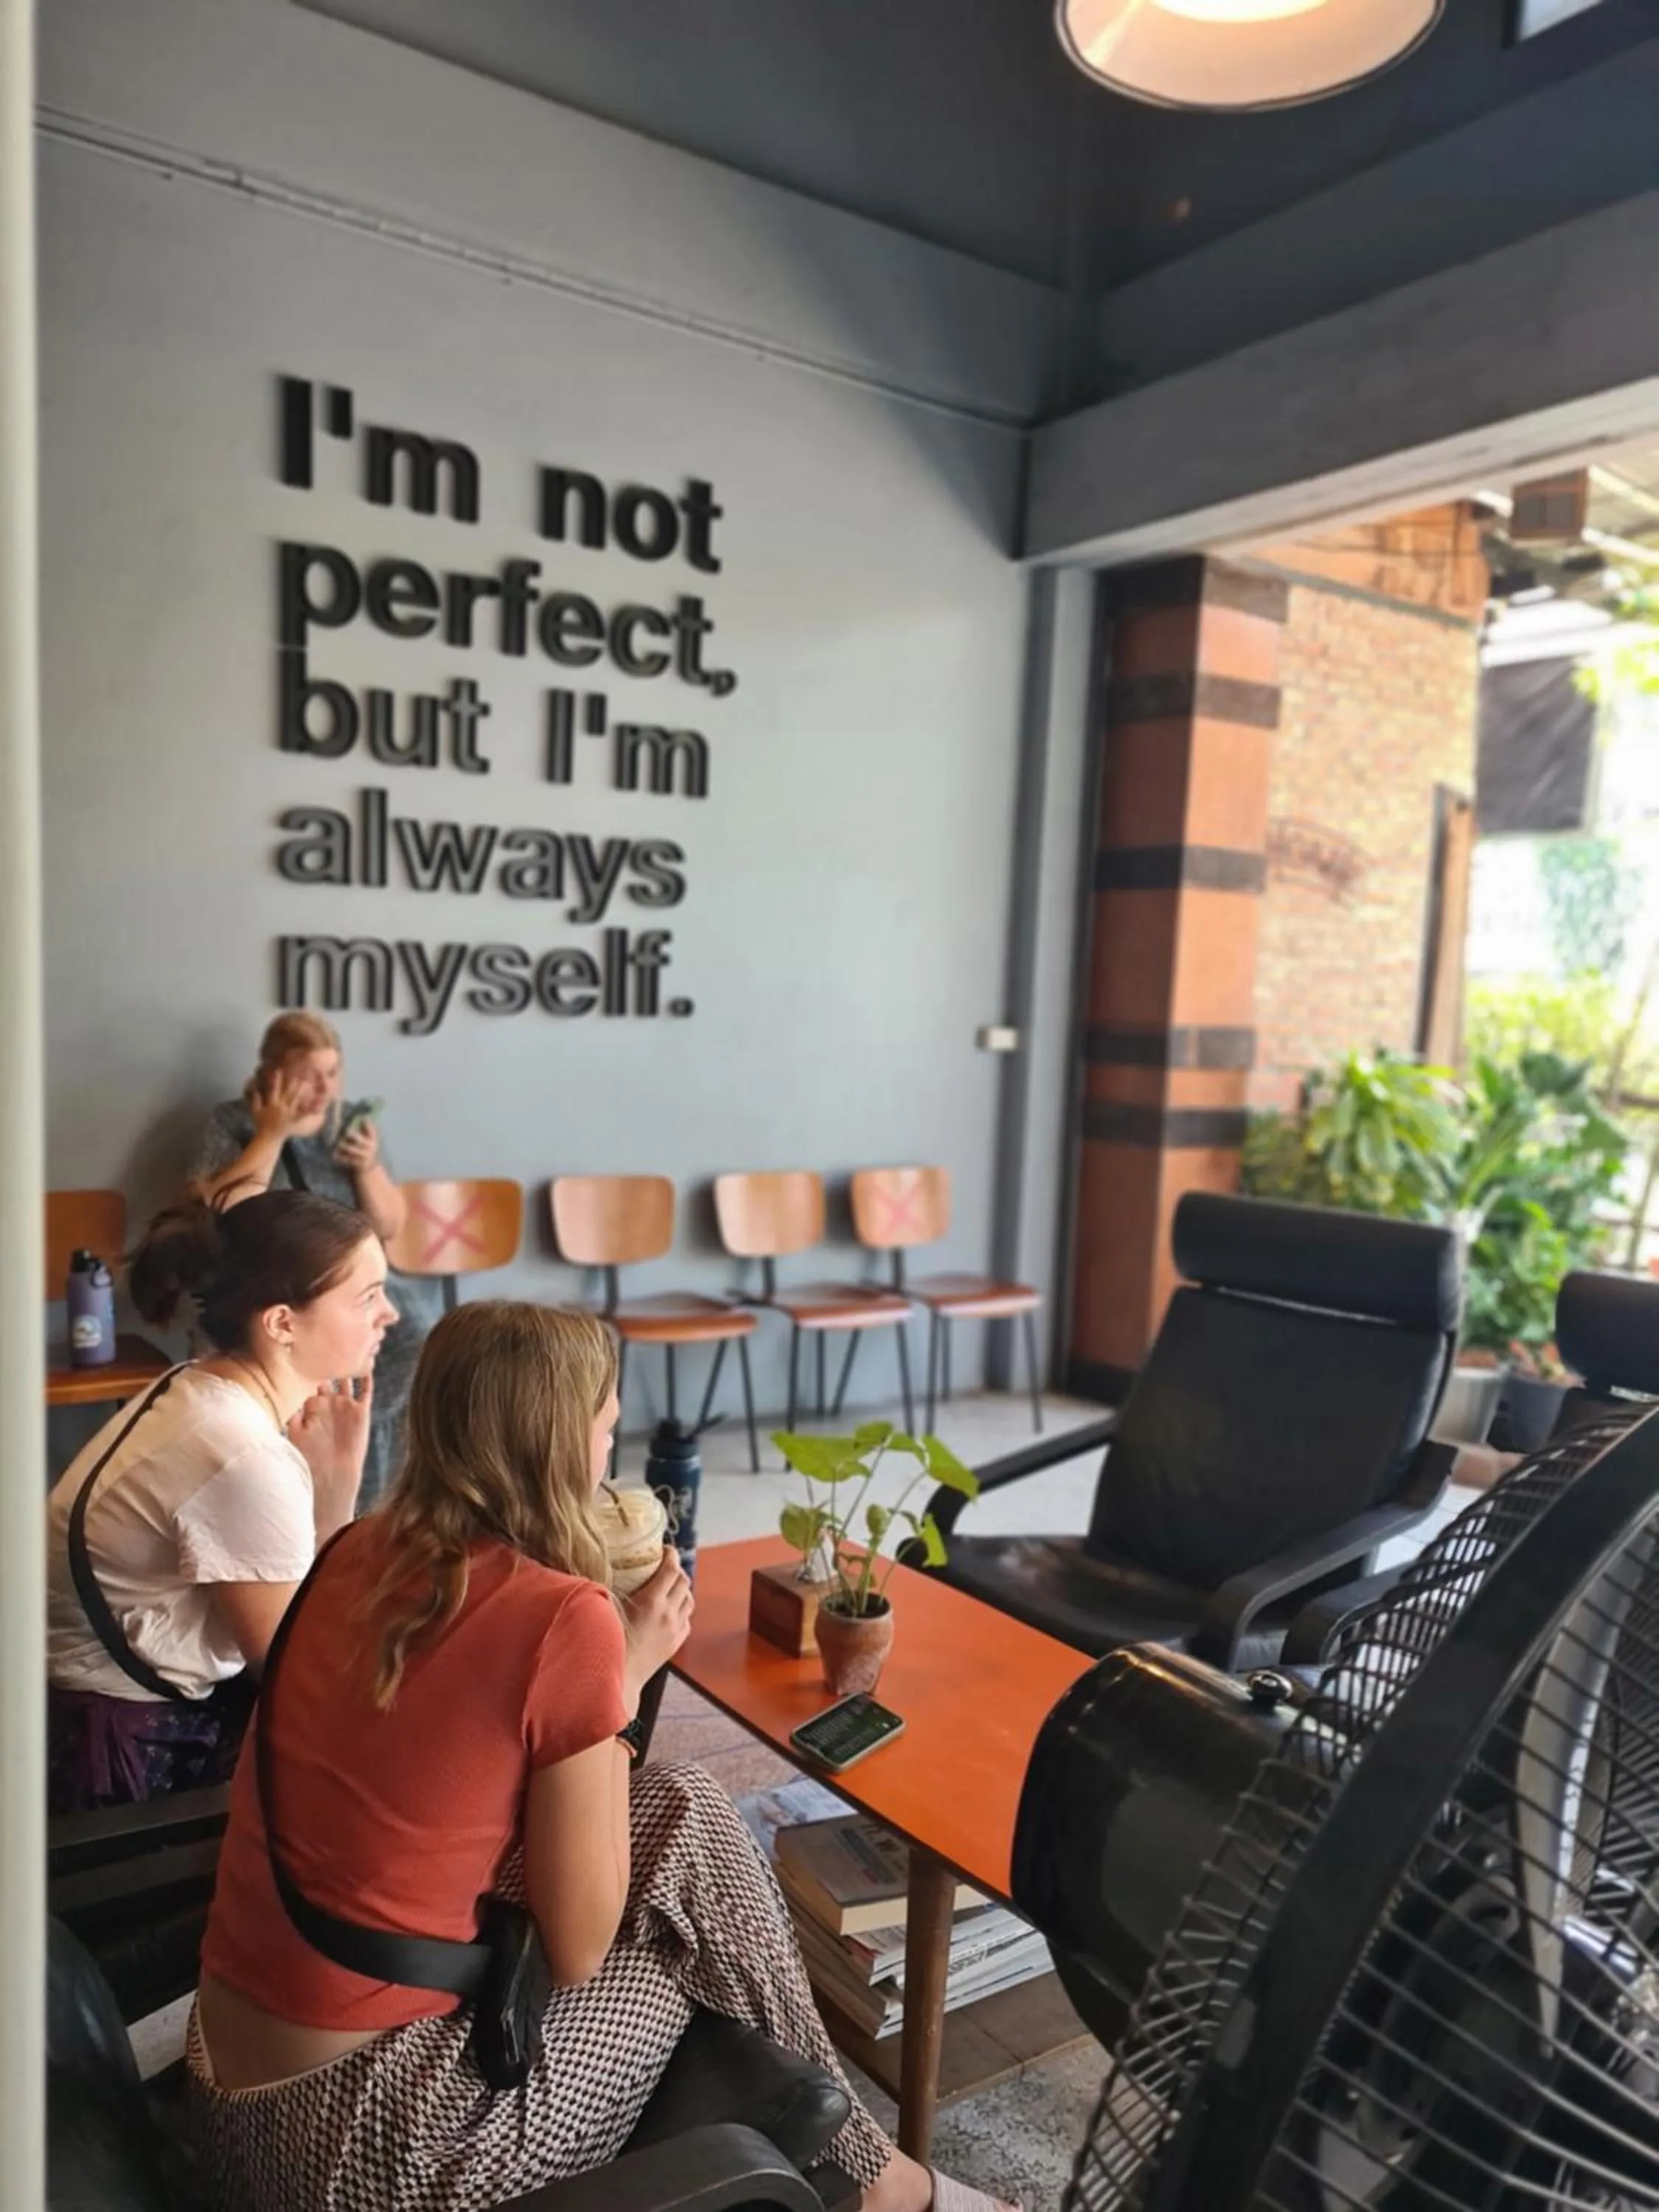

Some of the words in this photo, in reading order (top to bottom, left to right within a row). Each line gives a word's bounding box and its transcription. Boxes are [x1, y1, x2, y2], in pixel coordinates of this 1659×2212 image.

[276, 375, 479, 525] I'm
[536, 463, 723, 574] not
[276, 539, 738, 698] perfect,
[276, 647, 491, 774] but
[544, 687, 709, 799] I'm
[274, 786, 686, 925] always
[276, 927, 695, 1034] myself.
